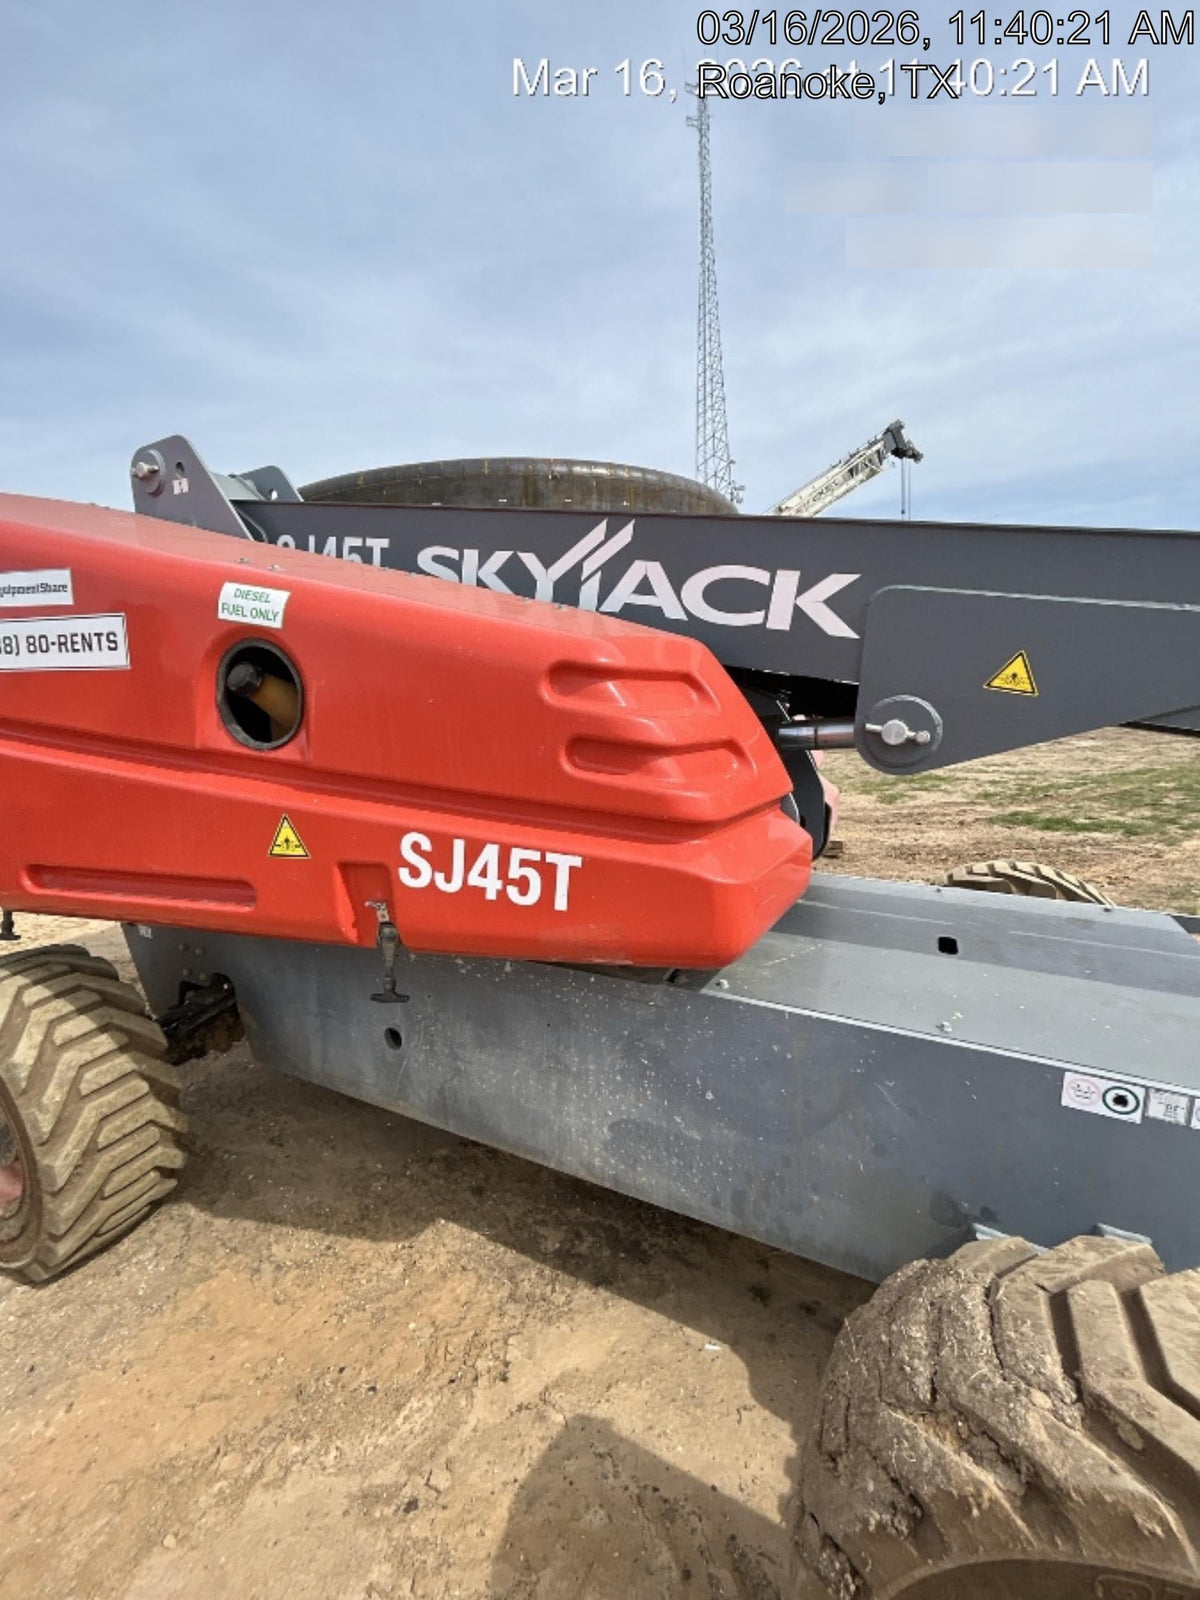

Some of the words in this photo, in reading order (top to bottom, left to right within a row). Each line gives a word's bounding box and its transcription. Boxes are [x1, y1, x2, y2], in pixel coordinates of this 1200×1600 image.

[233, 587, 272, 604] DIESEL
[221, 602, 248, 618] FUEL
[250, 606, 280, 623] ONLY
[0, 634, 20, 656] 8)
[26, 631, 118, 654] 80-RENTS
[398, 832, 582, 911] SJ45T
